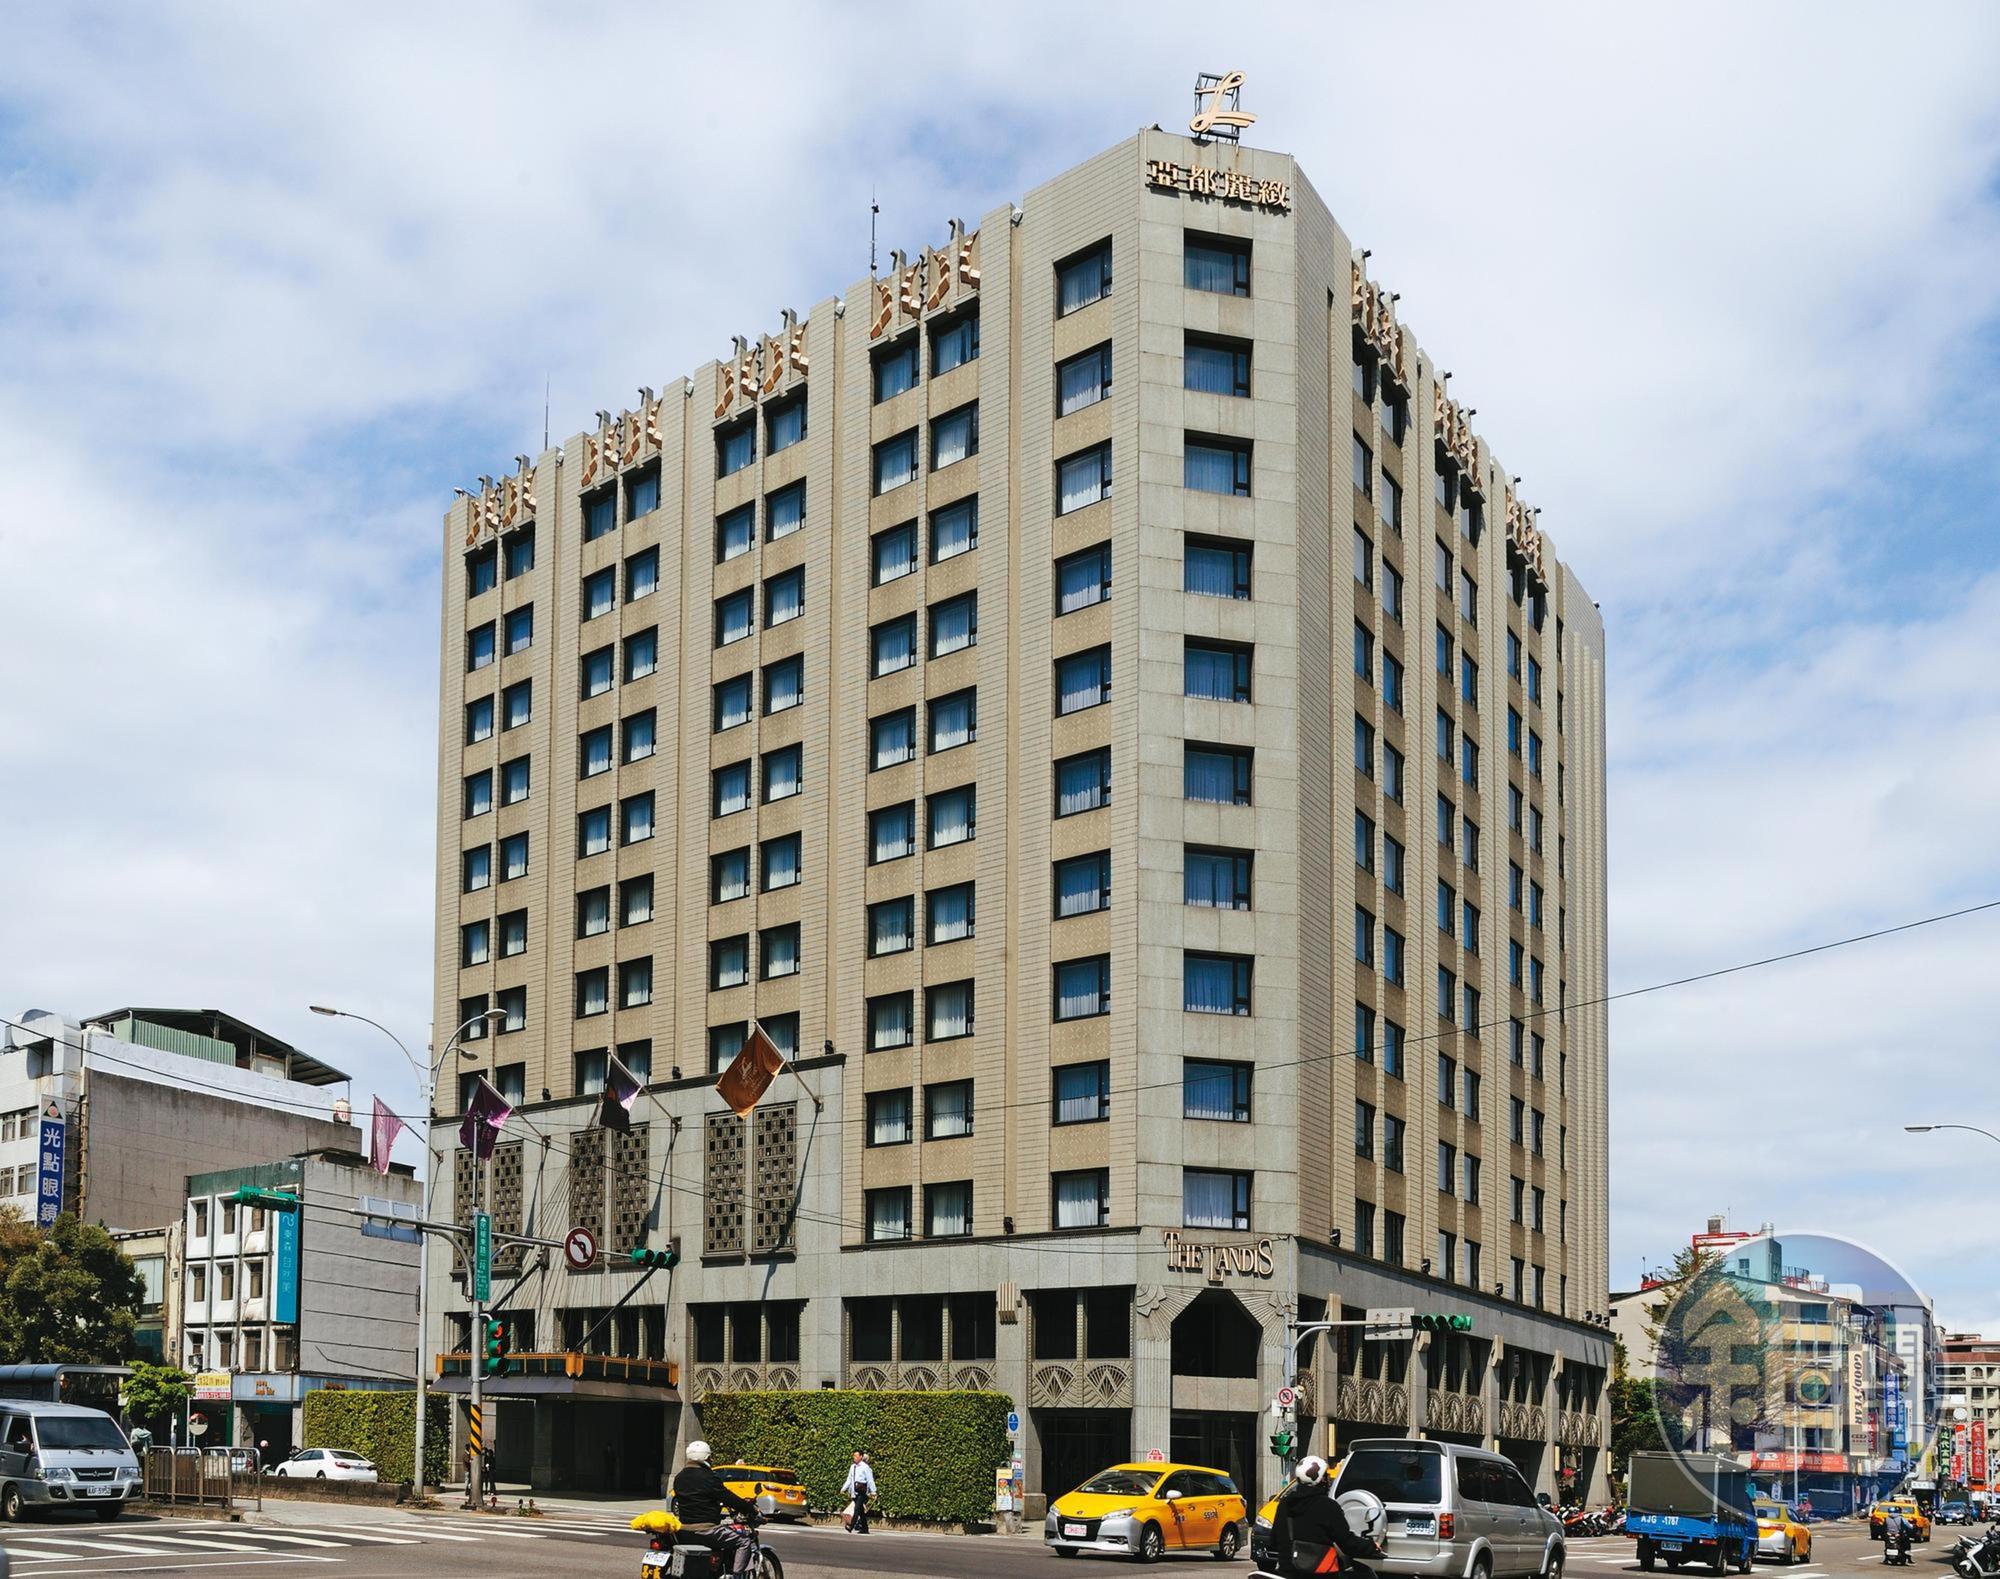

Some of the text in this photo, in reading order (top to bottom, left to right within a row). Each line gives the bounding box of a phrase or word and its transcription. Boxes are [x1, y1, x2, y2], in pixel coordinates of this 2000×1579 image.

[1147, 160, 1291, 209] 亞都麗緻
[40, 1127, 61, 1222] 光點眼鏡
[1164, 1231, 1274, 1283] THE LANDIS
[1853, 1353, 1864, 1424] GOODYEAR
